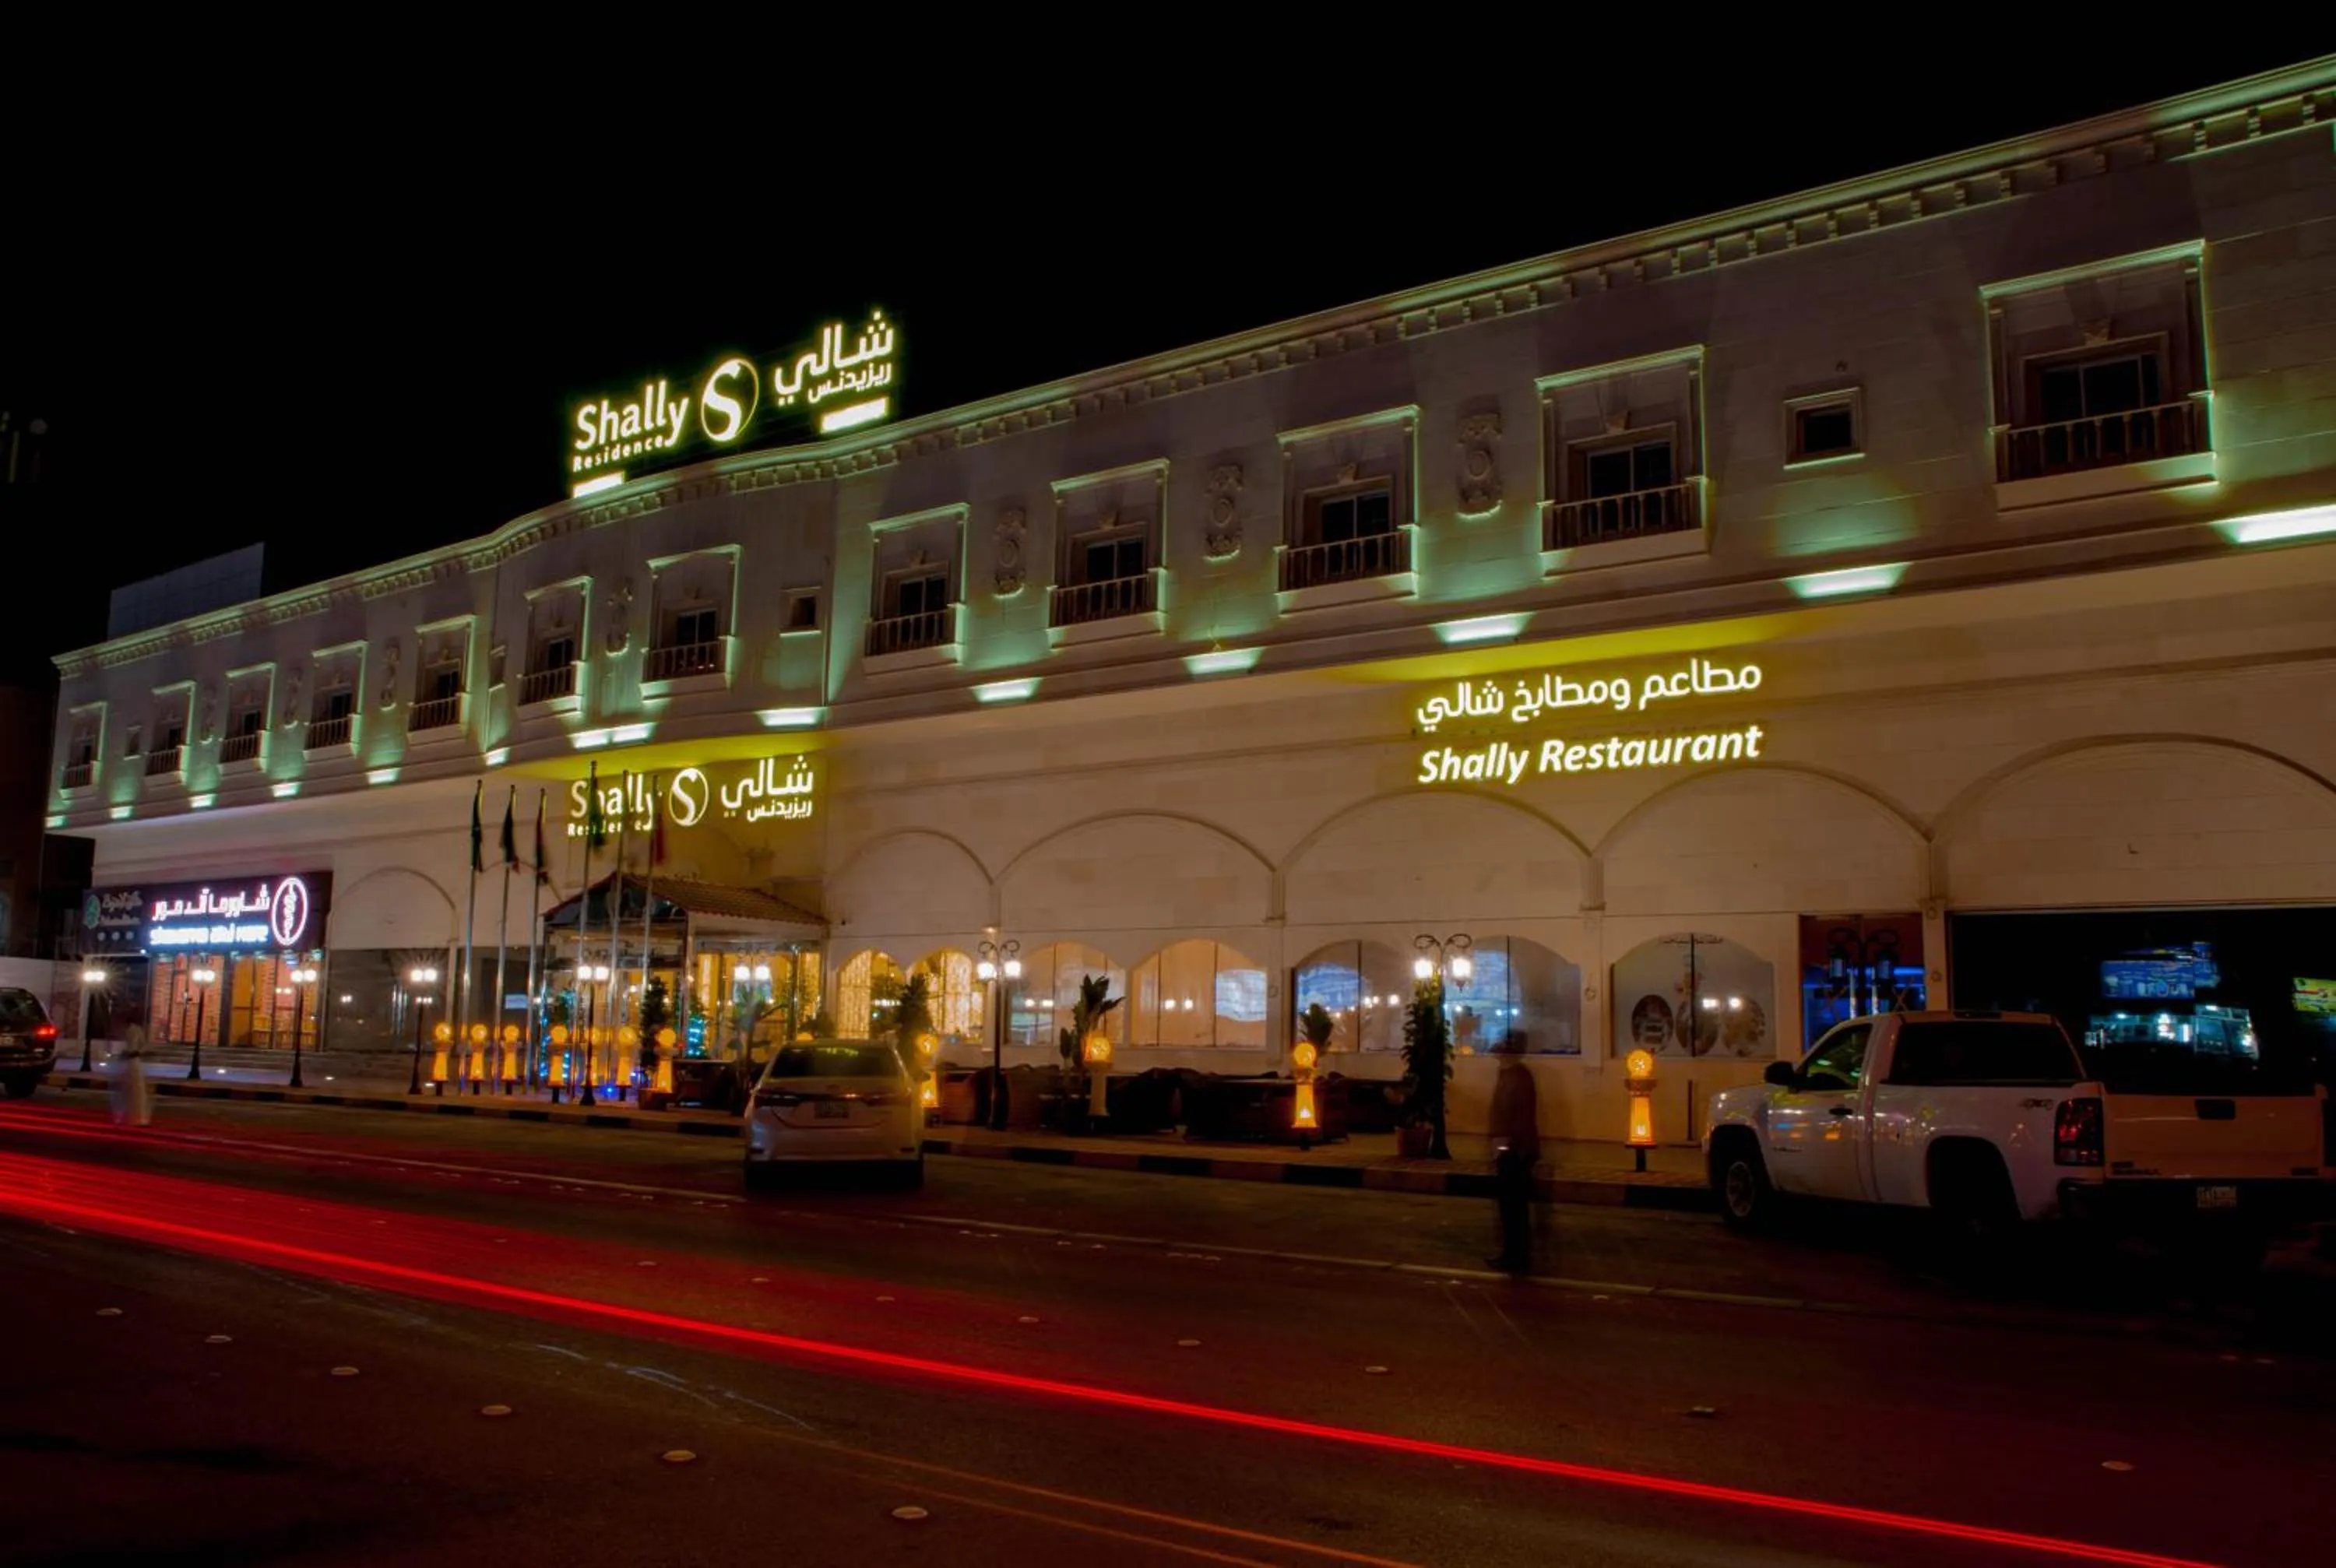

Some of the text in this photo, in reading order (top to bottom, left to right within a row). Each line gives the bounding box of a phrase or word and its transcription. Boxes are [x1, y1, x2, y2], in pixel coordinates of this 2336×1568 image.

[774, 311, 894, 406] شالي
[807, 362, 892, 403] ريزيدنس
[575, 380, 690, 449] Shally
[573, 434, 664, 473] Residence
[1417, 659, 1762, 732] مطاعم ومطابخ شالي
[1418, 725, 1764, 784] Shally Restaurant
[721, 754, 814, 817] شالي
[747, 797, 813, 822] ريزيدنس
